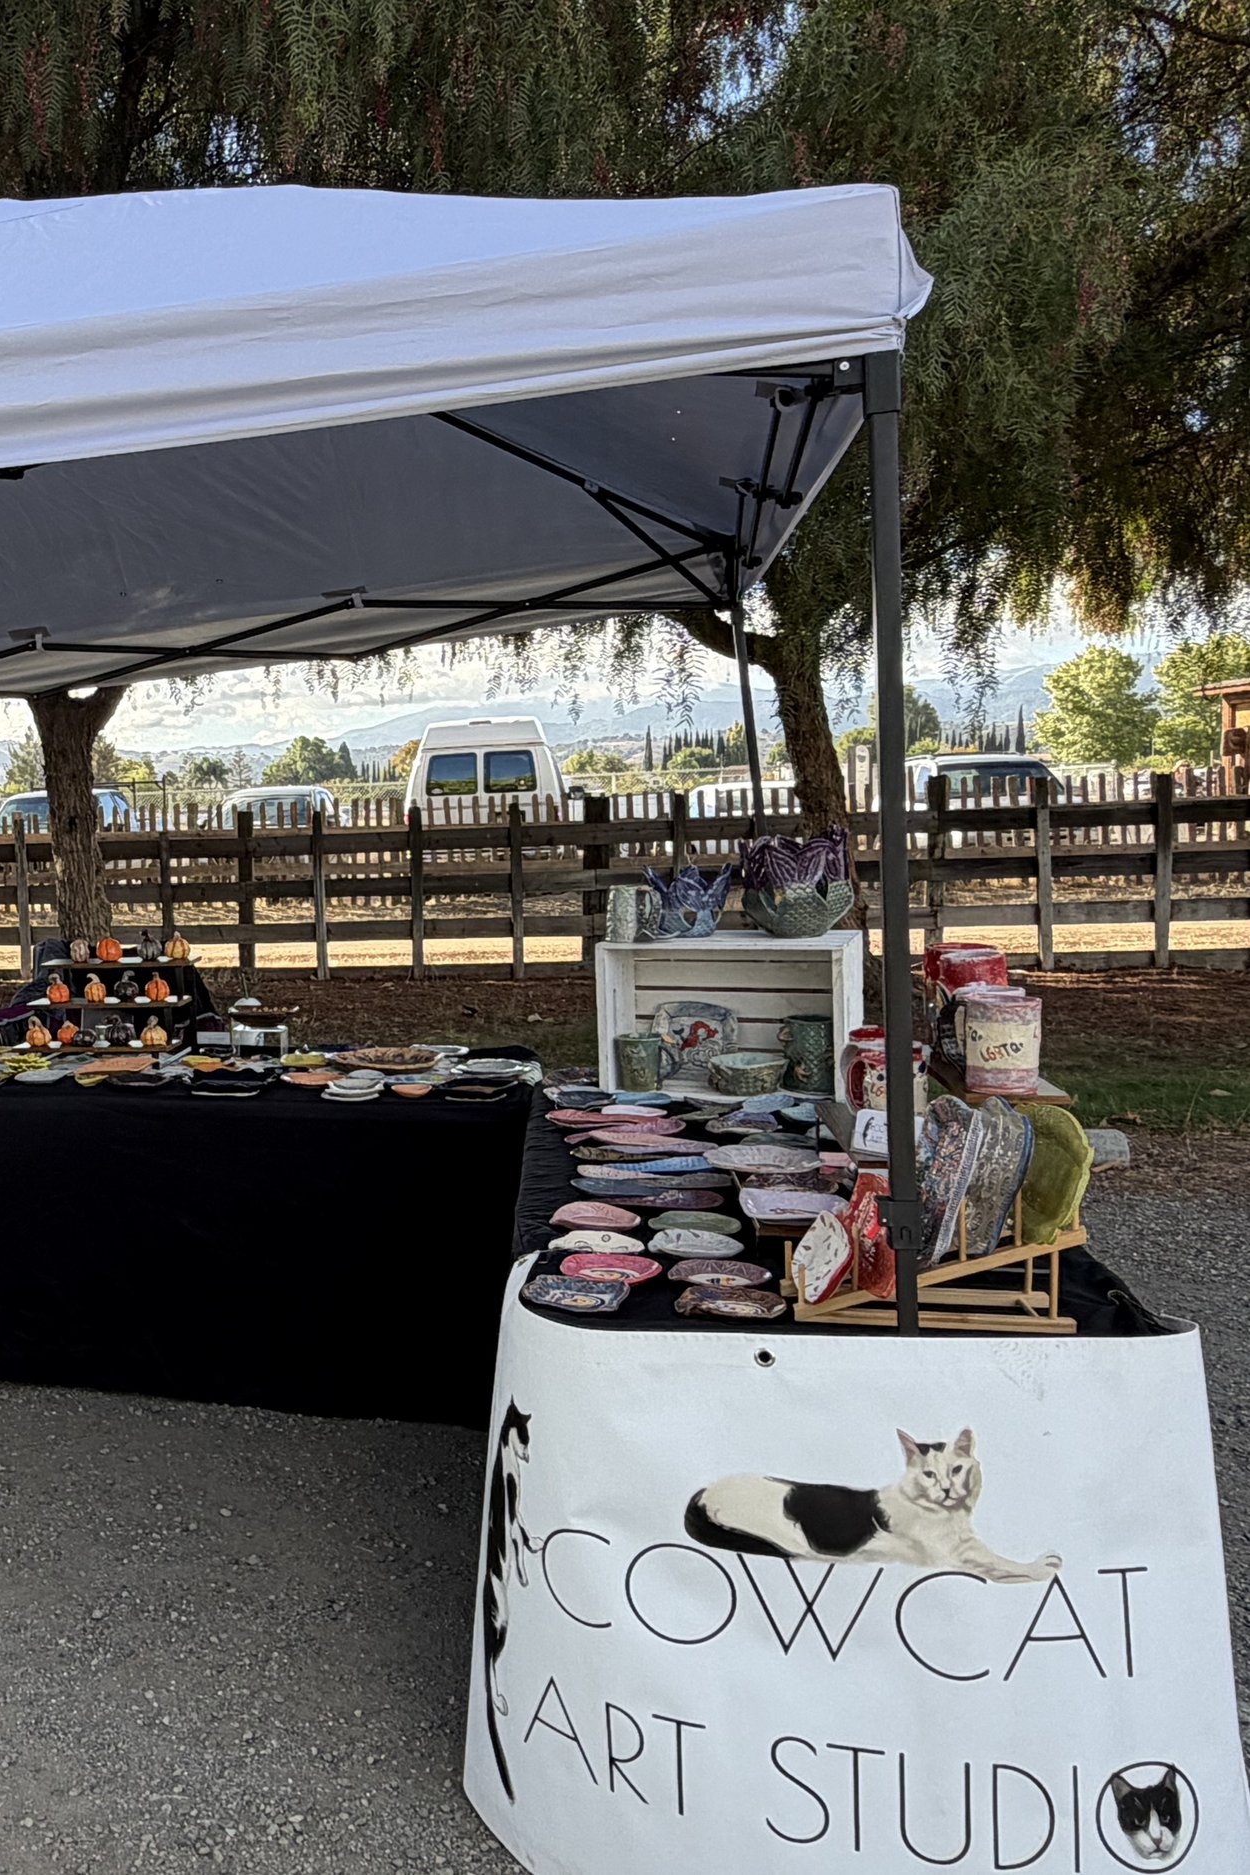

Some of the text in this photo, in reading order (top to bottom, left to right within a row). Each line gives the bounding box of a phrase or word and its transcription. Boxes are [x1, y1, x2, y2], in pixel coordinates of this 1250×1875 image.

[541, 1528, 1147, 1682] COWCAT
[523, 1676, 1199, 1875] ART STUDIO
